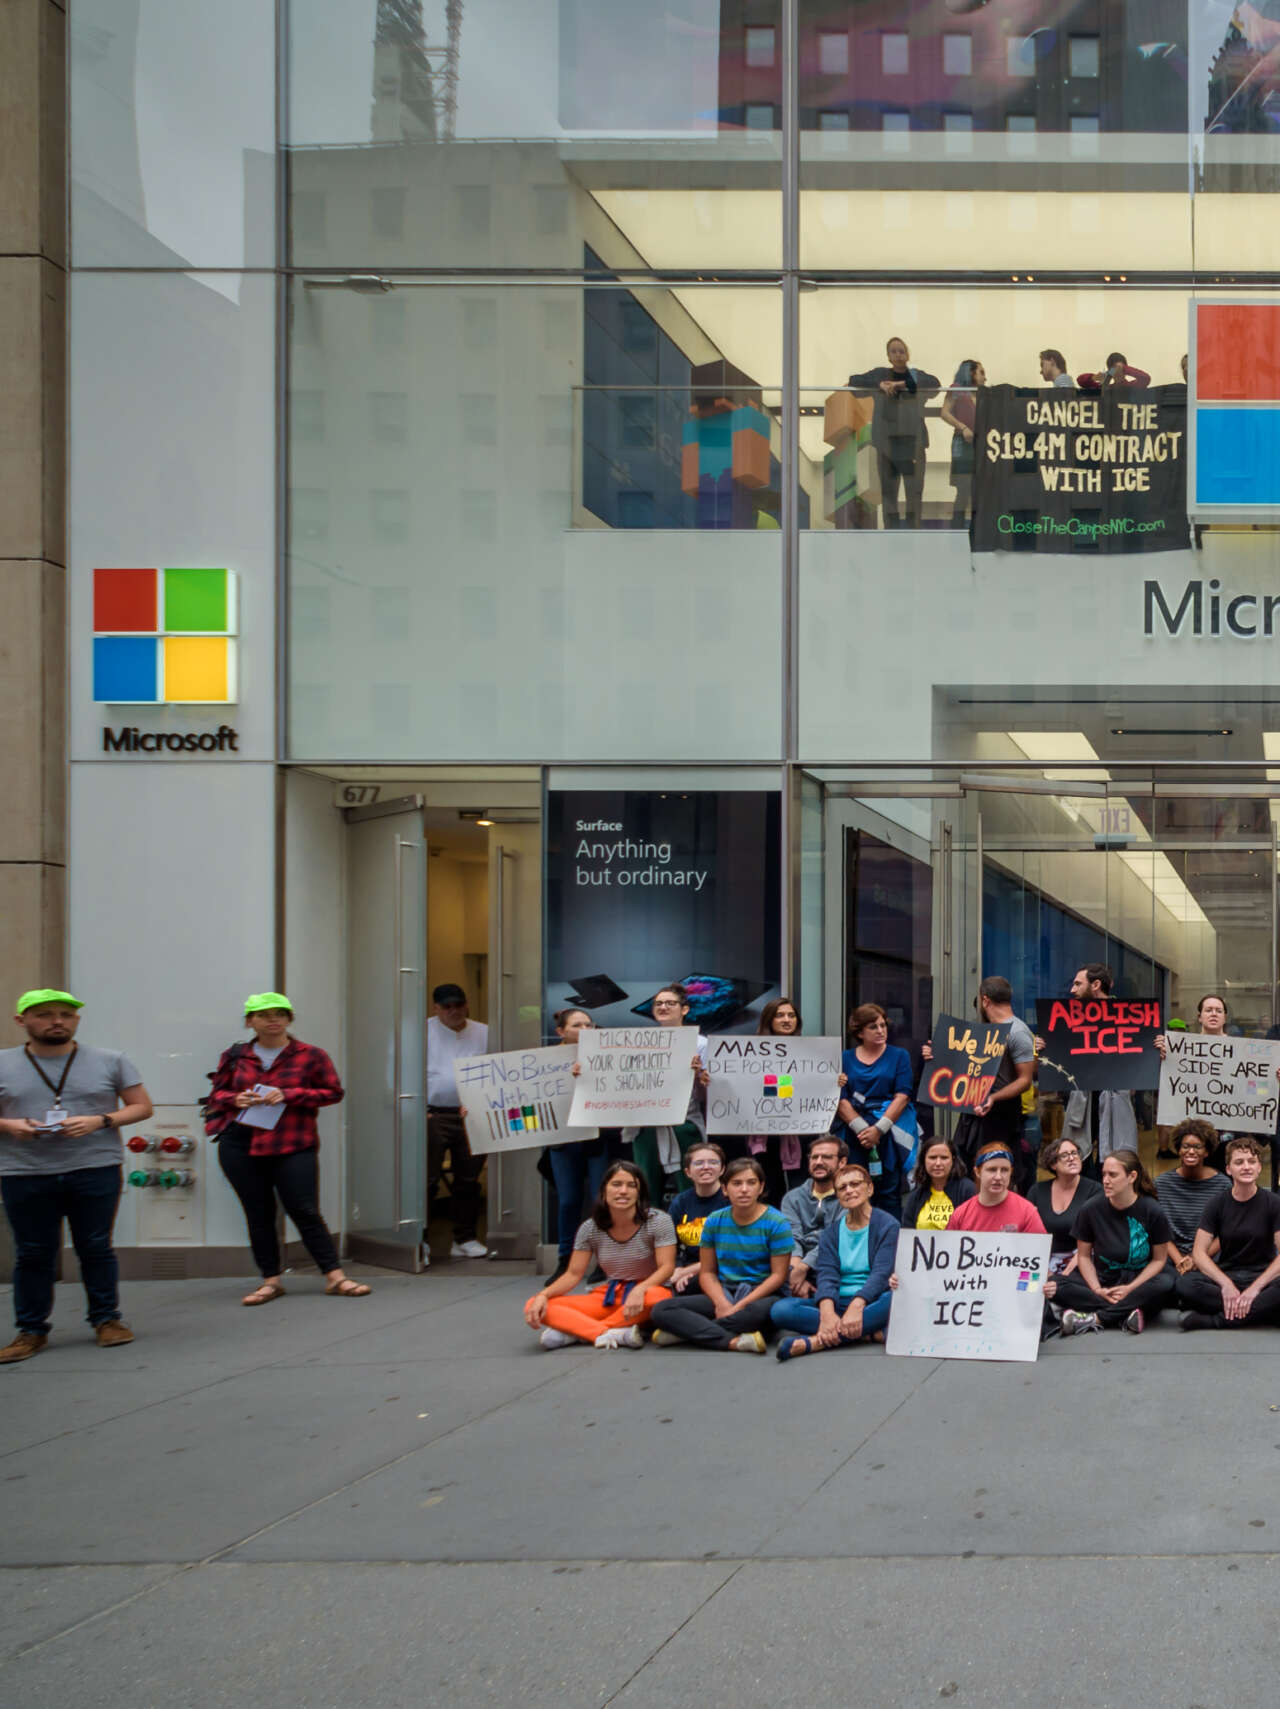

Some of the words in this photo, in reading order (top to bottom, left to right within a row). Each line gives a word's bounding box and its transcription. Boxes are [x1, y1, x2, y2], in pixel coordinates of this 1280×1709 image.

[1026, 401, 1104, 429] CANCEL
[1118, 403, 1158, 430] THE
[986, 429, 1066, 463] $19.4M
[1075, 431, 1182, 463] CONTRACT
[1040, 465, 1101, 492] WITH
[1112, 468, 1150, 492] ICE
[997, 515, 1165, 541] CloseTheCampsNYC.com
[103, 725, 239, 752] Microsoft
[344, 785, 381, 803] 677
[575, 820, 623, 831] Surface
[576, 838, 671, 864] Anything
[576, 865, 612, 885] but
[617, 865, 707, 891] ordinary
[1048, 999, 1160, 1031] ABOLISH
[714, 1040, 788, 1057] MASS
[948, 1026, 977, 1054] We
[1070, 1025, 1143, 1054] ICE
[1167, 1035, 1233, 1058] WHICH
[587, 1054, 614, 1072] YOUR
[708, 1059, 840, 1074] DEPORTATION
[1178, 1058, 1224, 1076] SIDE
[1230, 1061, 1270, 1078] ARE
[533, 1079, 569, 1100] ICE
[595, 1076, 606, 1093] IS
[616, 1070, 664, 1092] SHOWING
[711, 1099, 740, 1119] ON
[752, 1097, 793, 1116] YOUR
[1185, 1096, 1277, 1128] MICROSOFT?
[929, 1205, 953, 1213] NEVE
[957, 1236, 1041, 1271] Business
[943, 1274, 988, 1292] with
[933, 1301, 985, 1327] ICE
